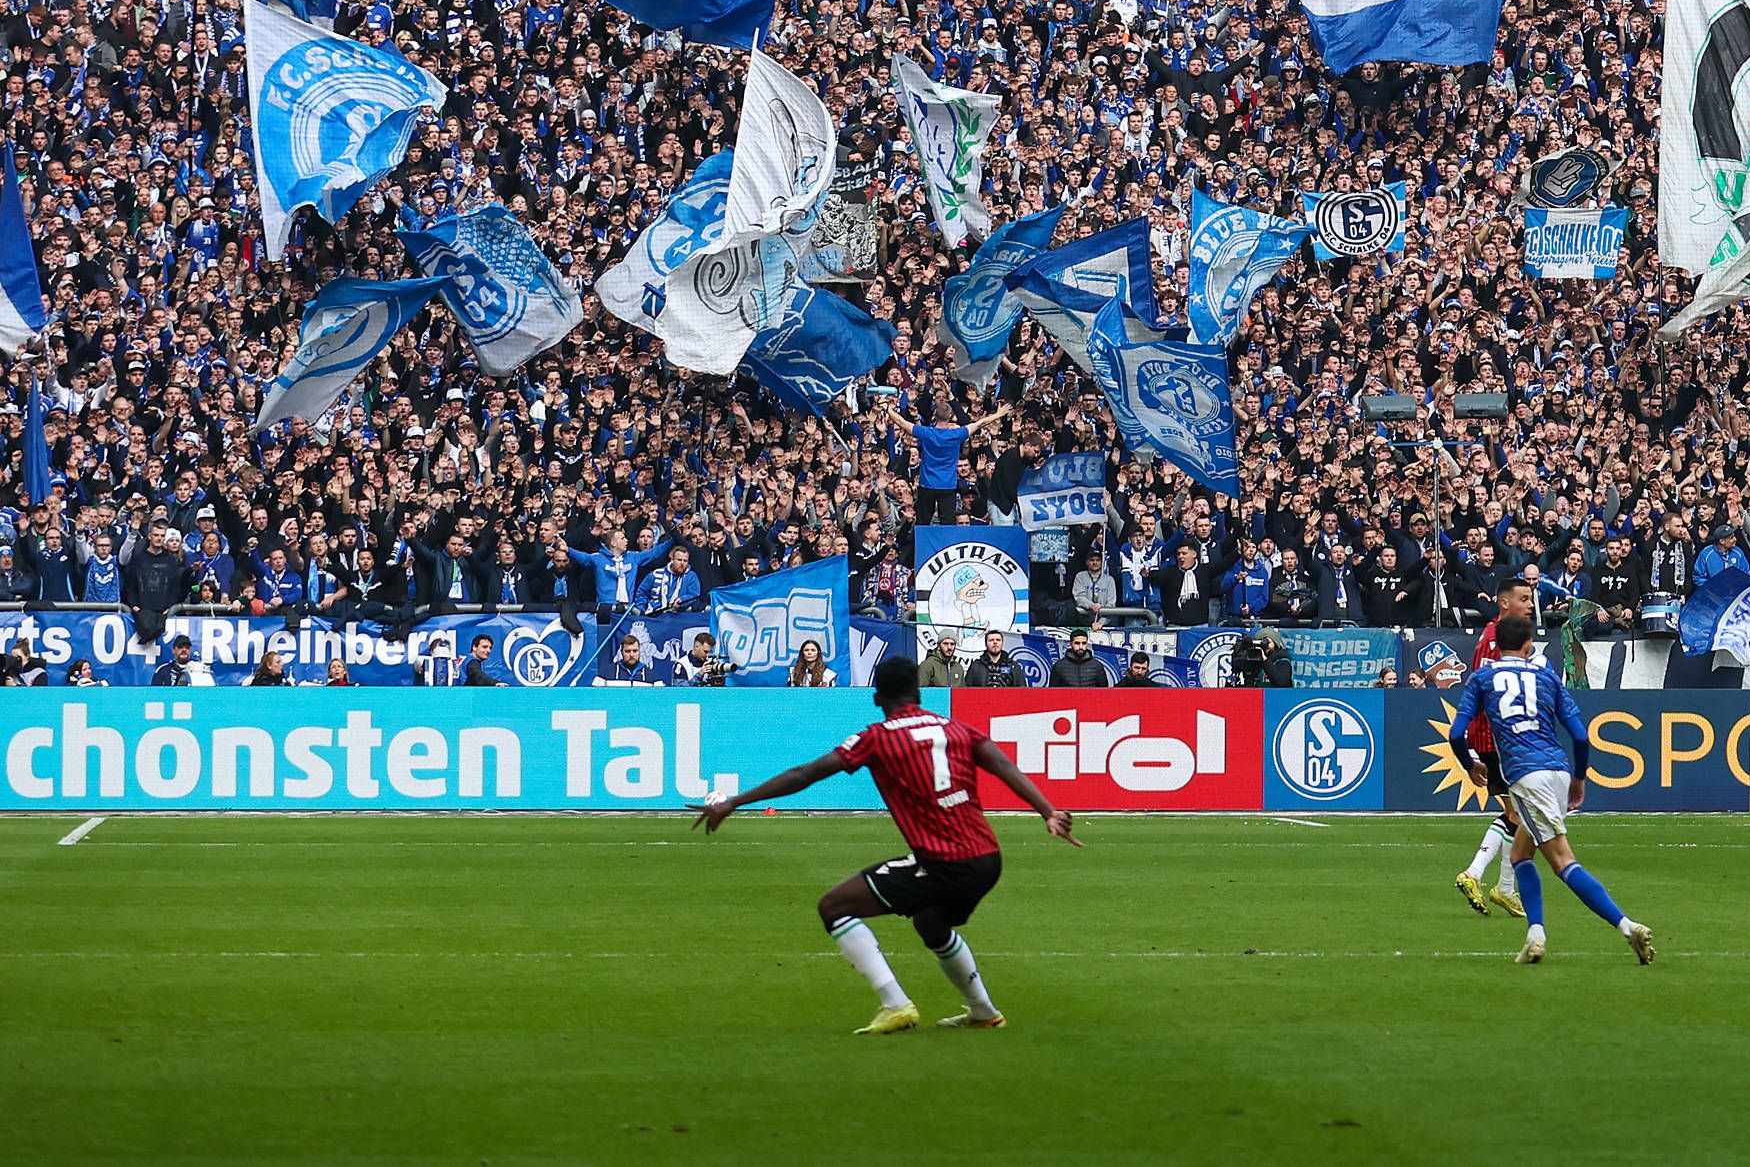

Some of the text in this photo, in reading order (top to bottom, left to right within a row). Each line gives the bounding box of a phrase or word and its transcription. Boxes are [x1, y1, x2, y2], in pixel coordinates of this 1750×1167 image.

[1193, 211, 1246, 265] BLUE
[1337, 238, 1380, 256] SCHALKE
[1379, 225, 1391, 242] 04
[1543, 222, 1597, 254] SCHALKE
[1585, 249, 1620, 268] Verein
[928, 544, 1018, 577] ULTRAS
[202, 617, 457, 666] Rheinberg
[1330, 638, 1370, 656] DIE
[1292, 658, 1358, 677] UNGS
[1492, 670, 1539, 721] 21
[6, 702, 740, 799] chönsten Tal.
[909, 725, 951, 793] 7
[989, 709, 1226, 792] Tirol
[1307, 765, 1337, 788] 04
